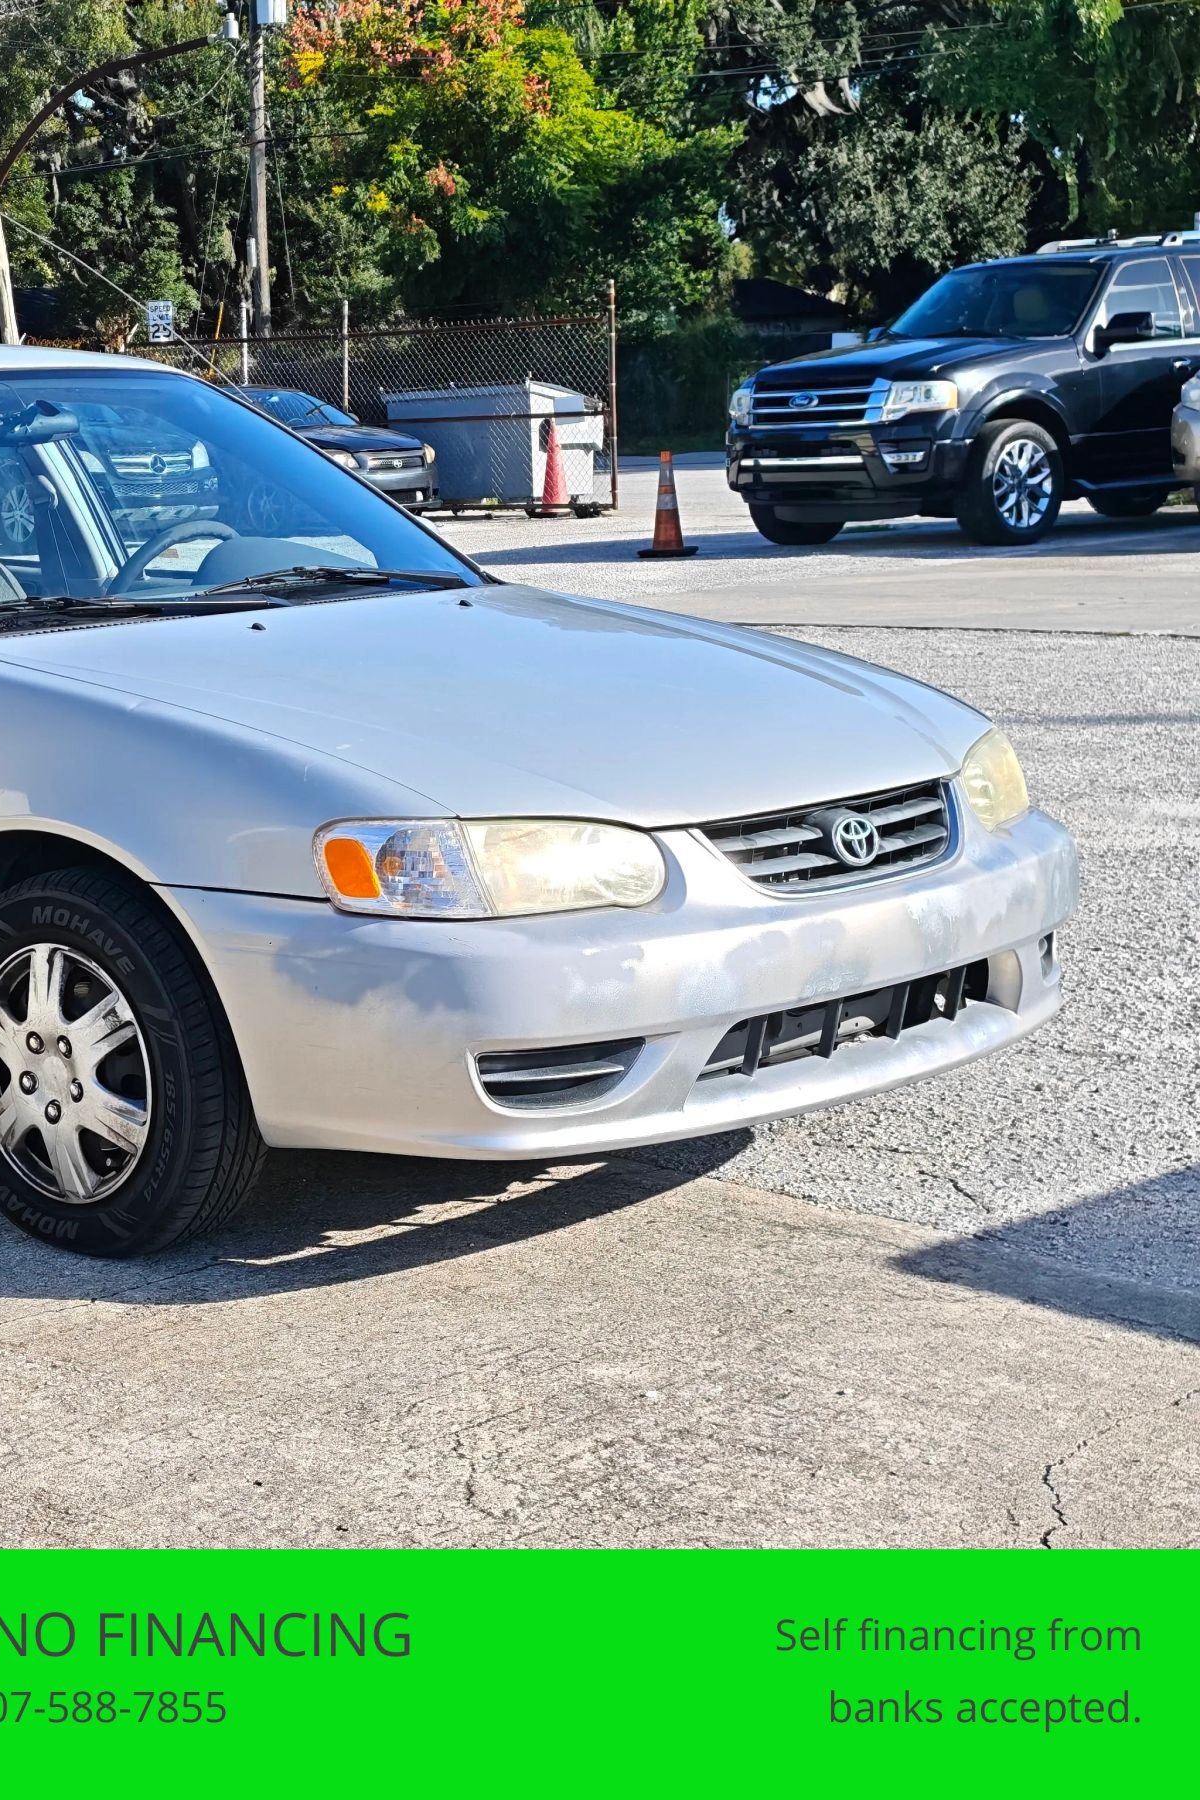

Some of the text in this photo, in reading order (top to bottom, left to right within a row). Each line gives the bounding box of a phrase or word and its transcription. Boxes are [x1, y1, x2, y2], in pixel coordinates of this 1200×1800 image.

[151, 323, 172, 339] 25
[31, 905, 136, 976] MOHAVE
[143, 1070, 176, 1203] 185/65R14
